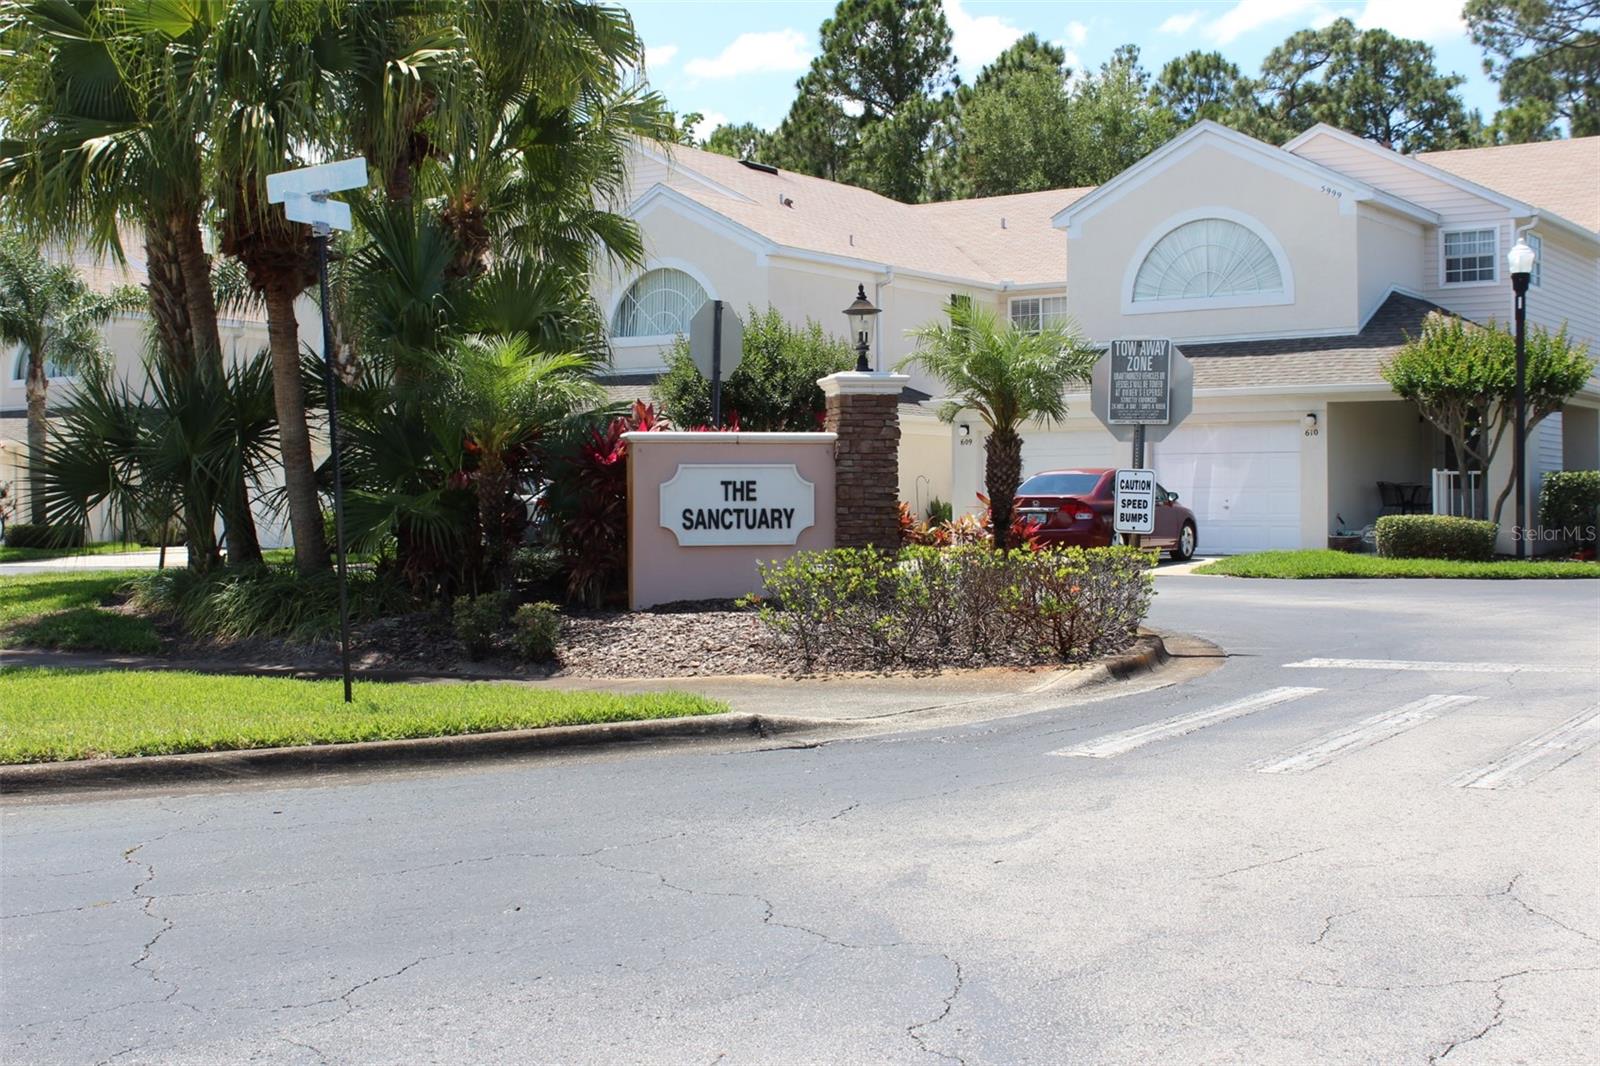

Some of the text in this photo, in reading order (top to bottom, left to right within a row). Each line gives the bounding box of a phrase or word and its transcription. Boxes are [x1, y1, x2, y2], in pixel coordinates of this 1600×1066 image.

[1115, 341, 1166, 356] TOW AWAY
[1127, 356, 1154, 372] ZONE
[1305, 428, 1318, 437] 610
[720, 480, 757, 502] THE
[1120, 480, 1151, 490] CAUTION
[1121, 498, 1148, 509] SPEED
[682, 508, 795, 530] SANCTUARY
[1120, 513, 1148, 523] BUMPS
